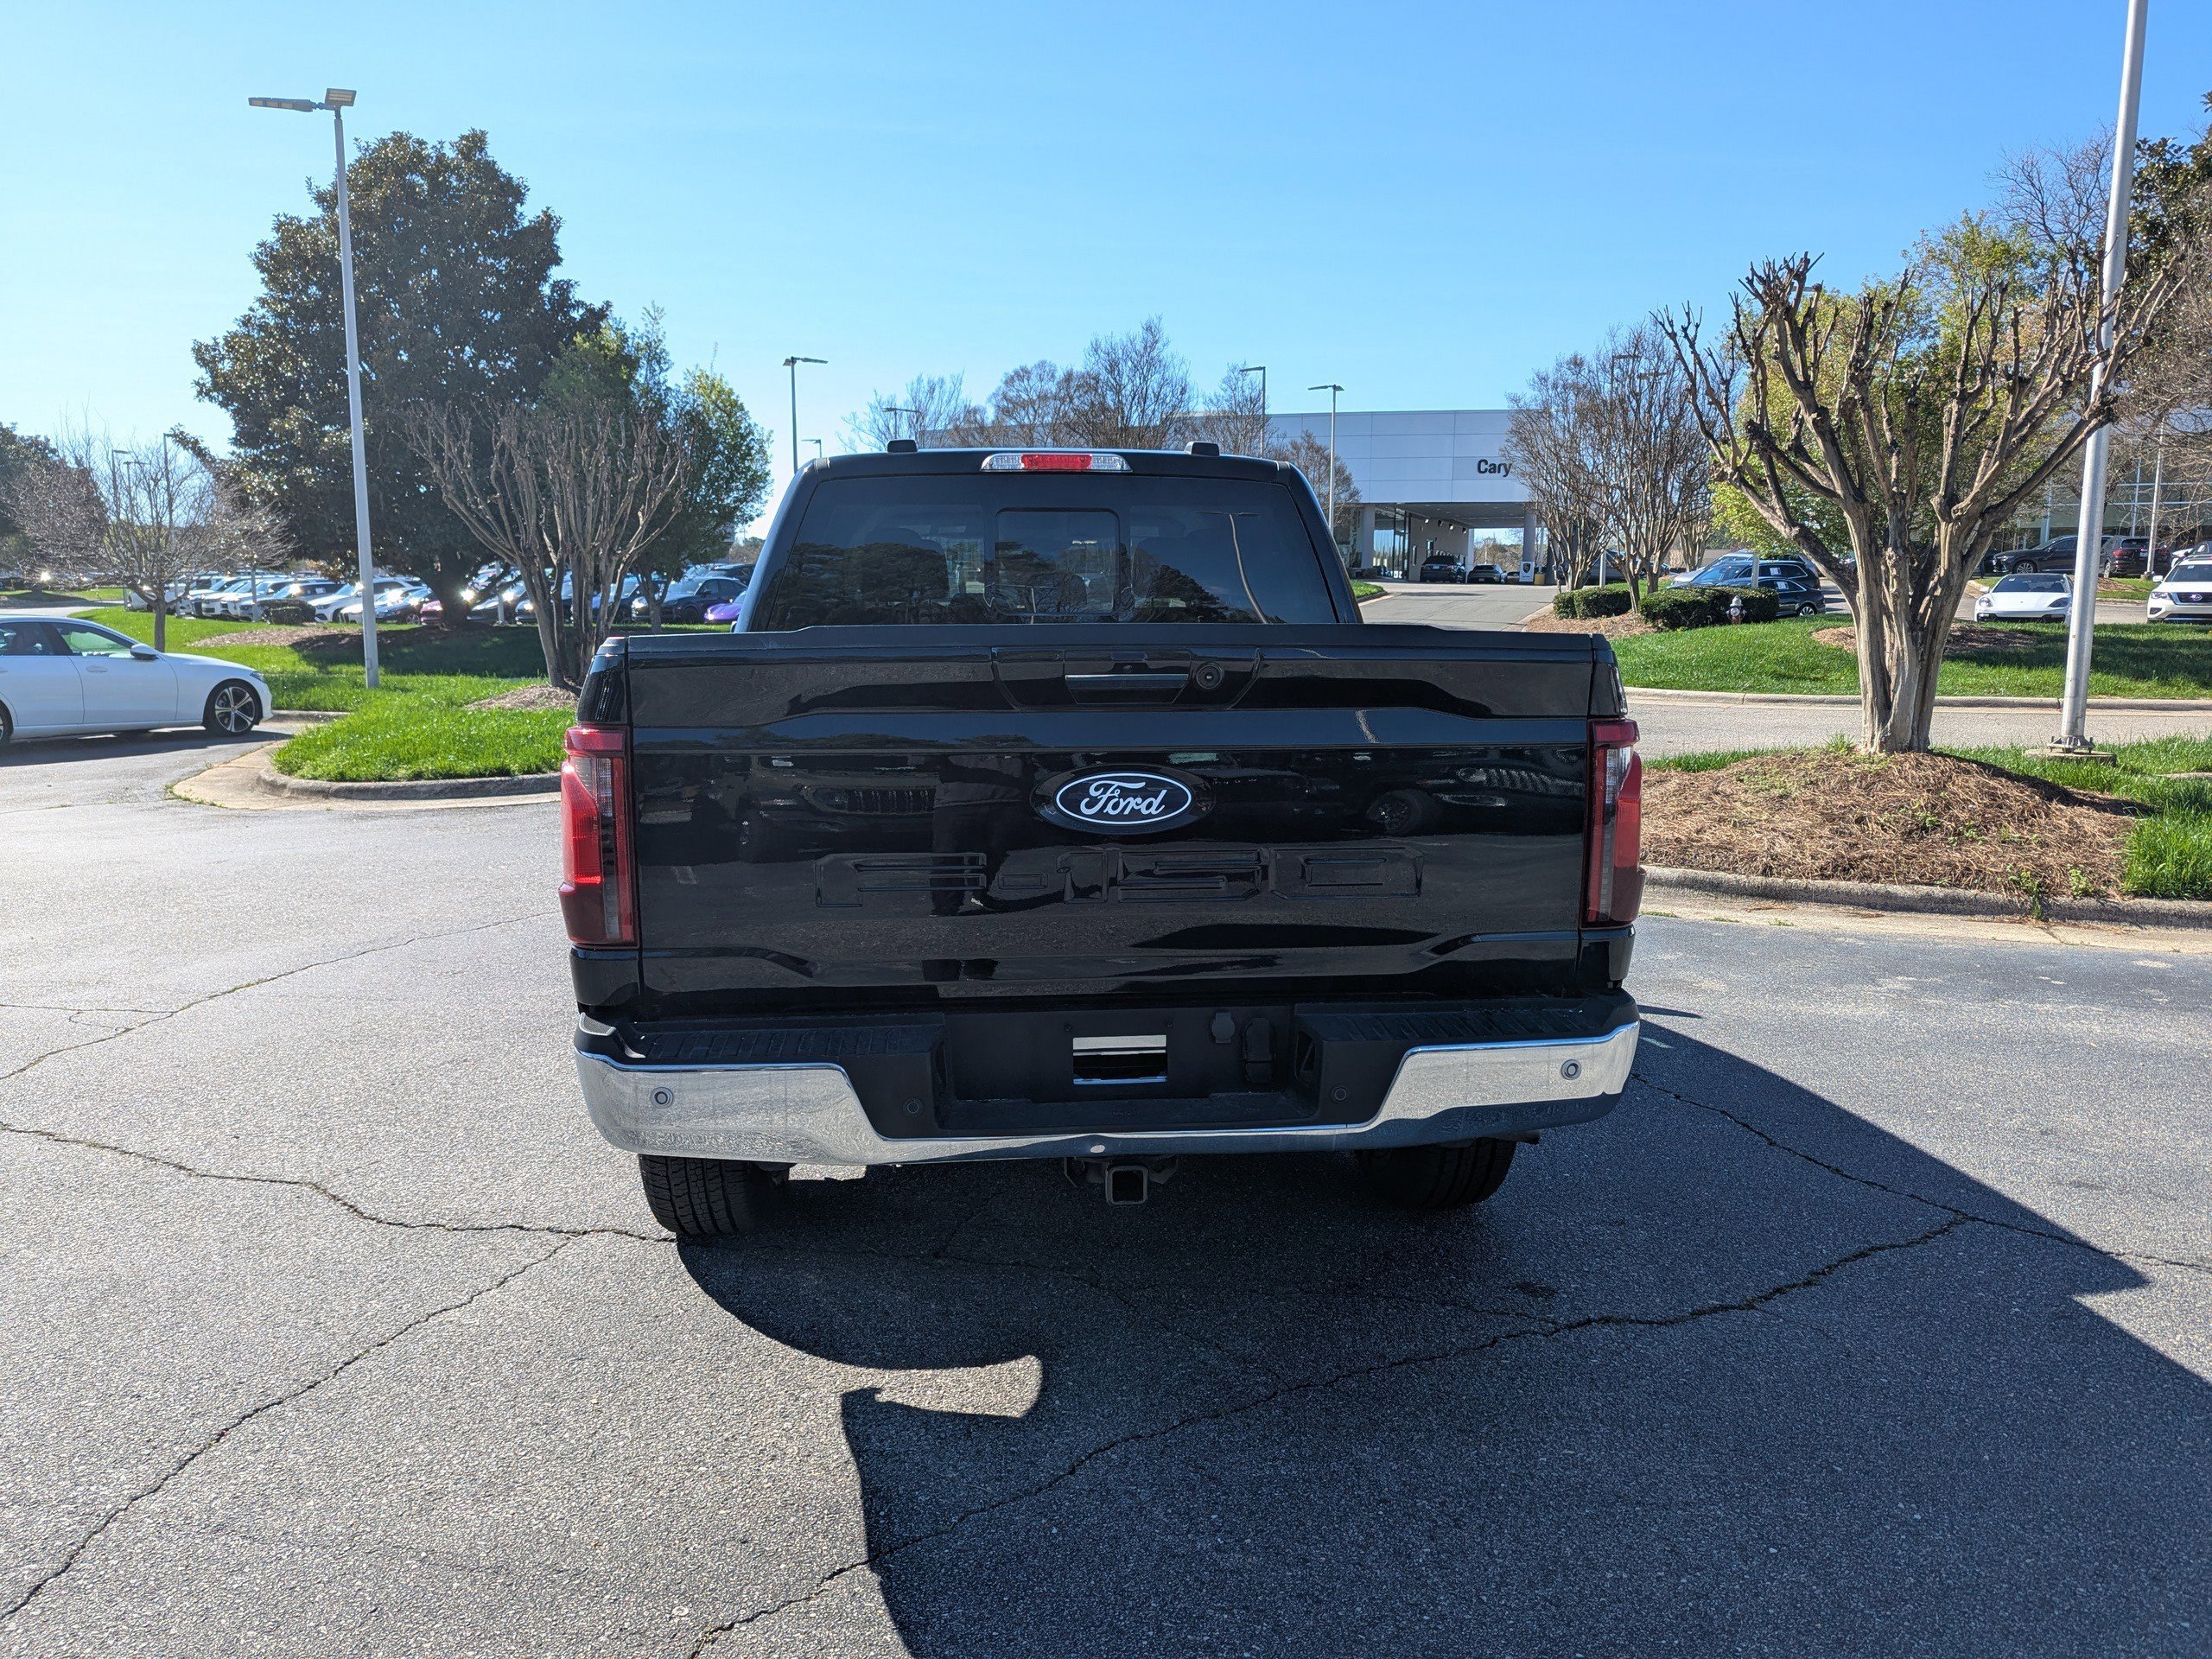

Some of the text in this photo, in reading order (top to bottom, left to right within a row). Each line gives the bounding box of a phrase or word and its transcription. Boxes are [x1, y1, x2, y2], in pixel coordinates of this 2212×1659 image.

[1477, 459, 1512, 477] Cary
[1080, 780, 1166, 815] Ford
[815, 847, 1424, 908] F-150
